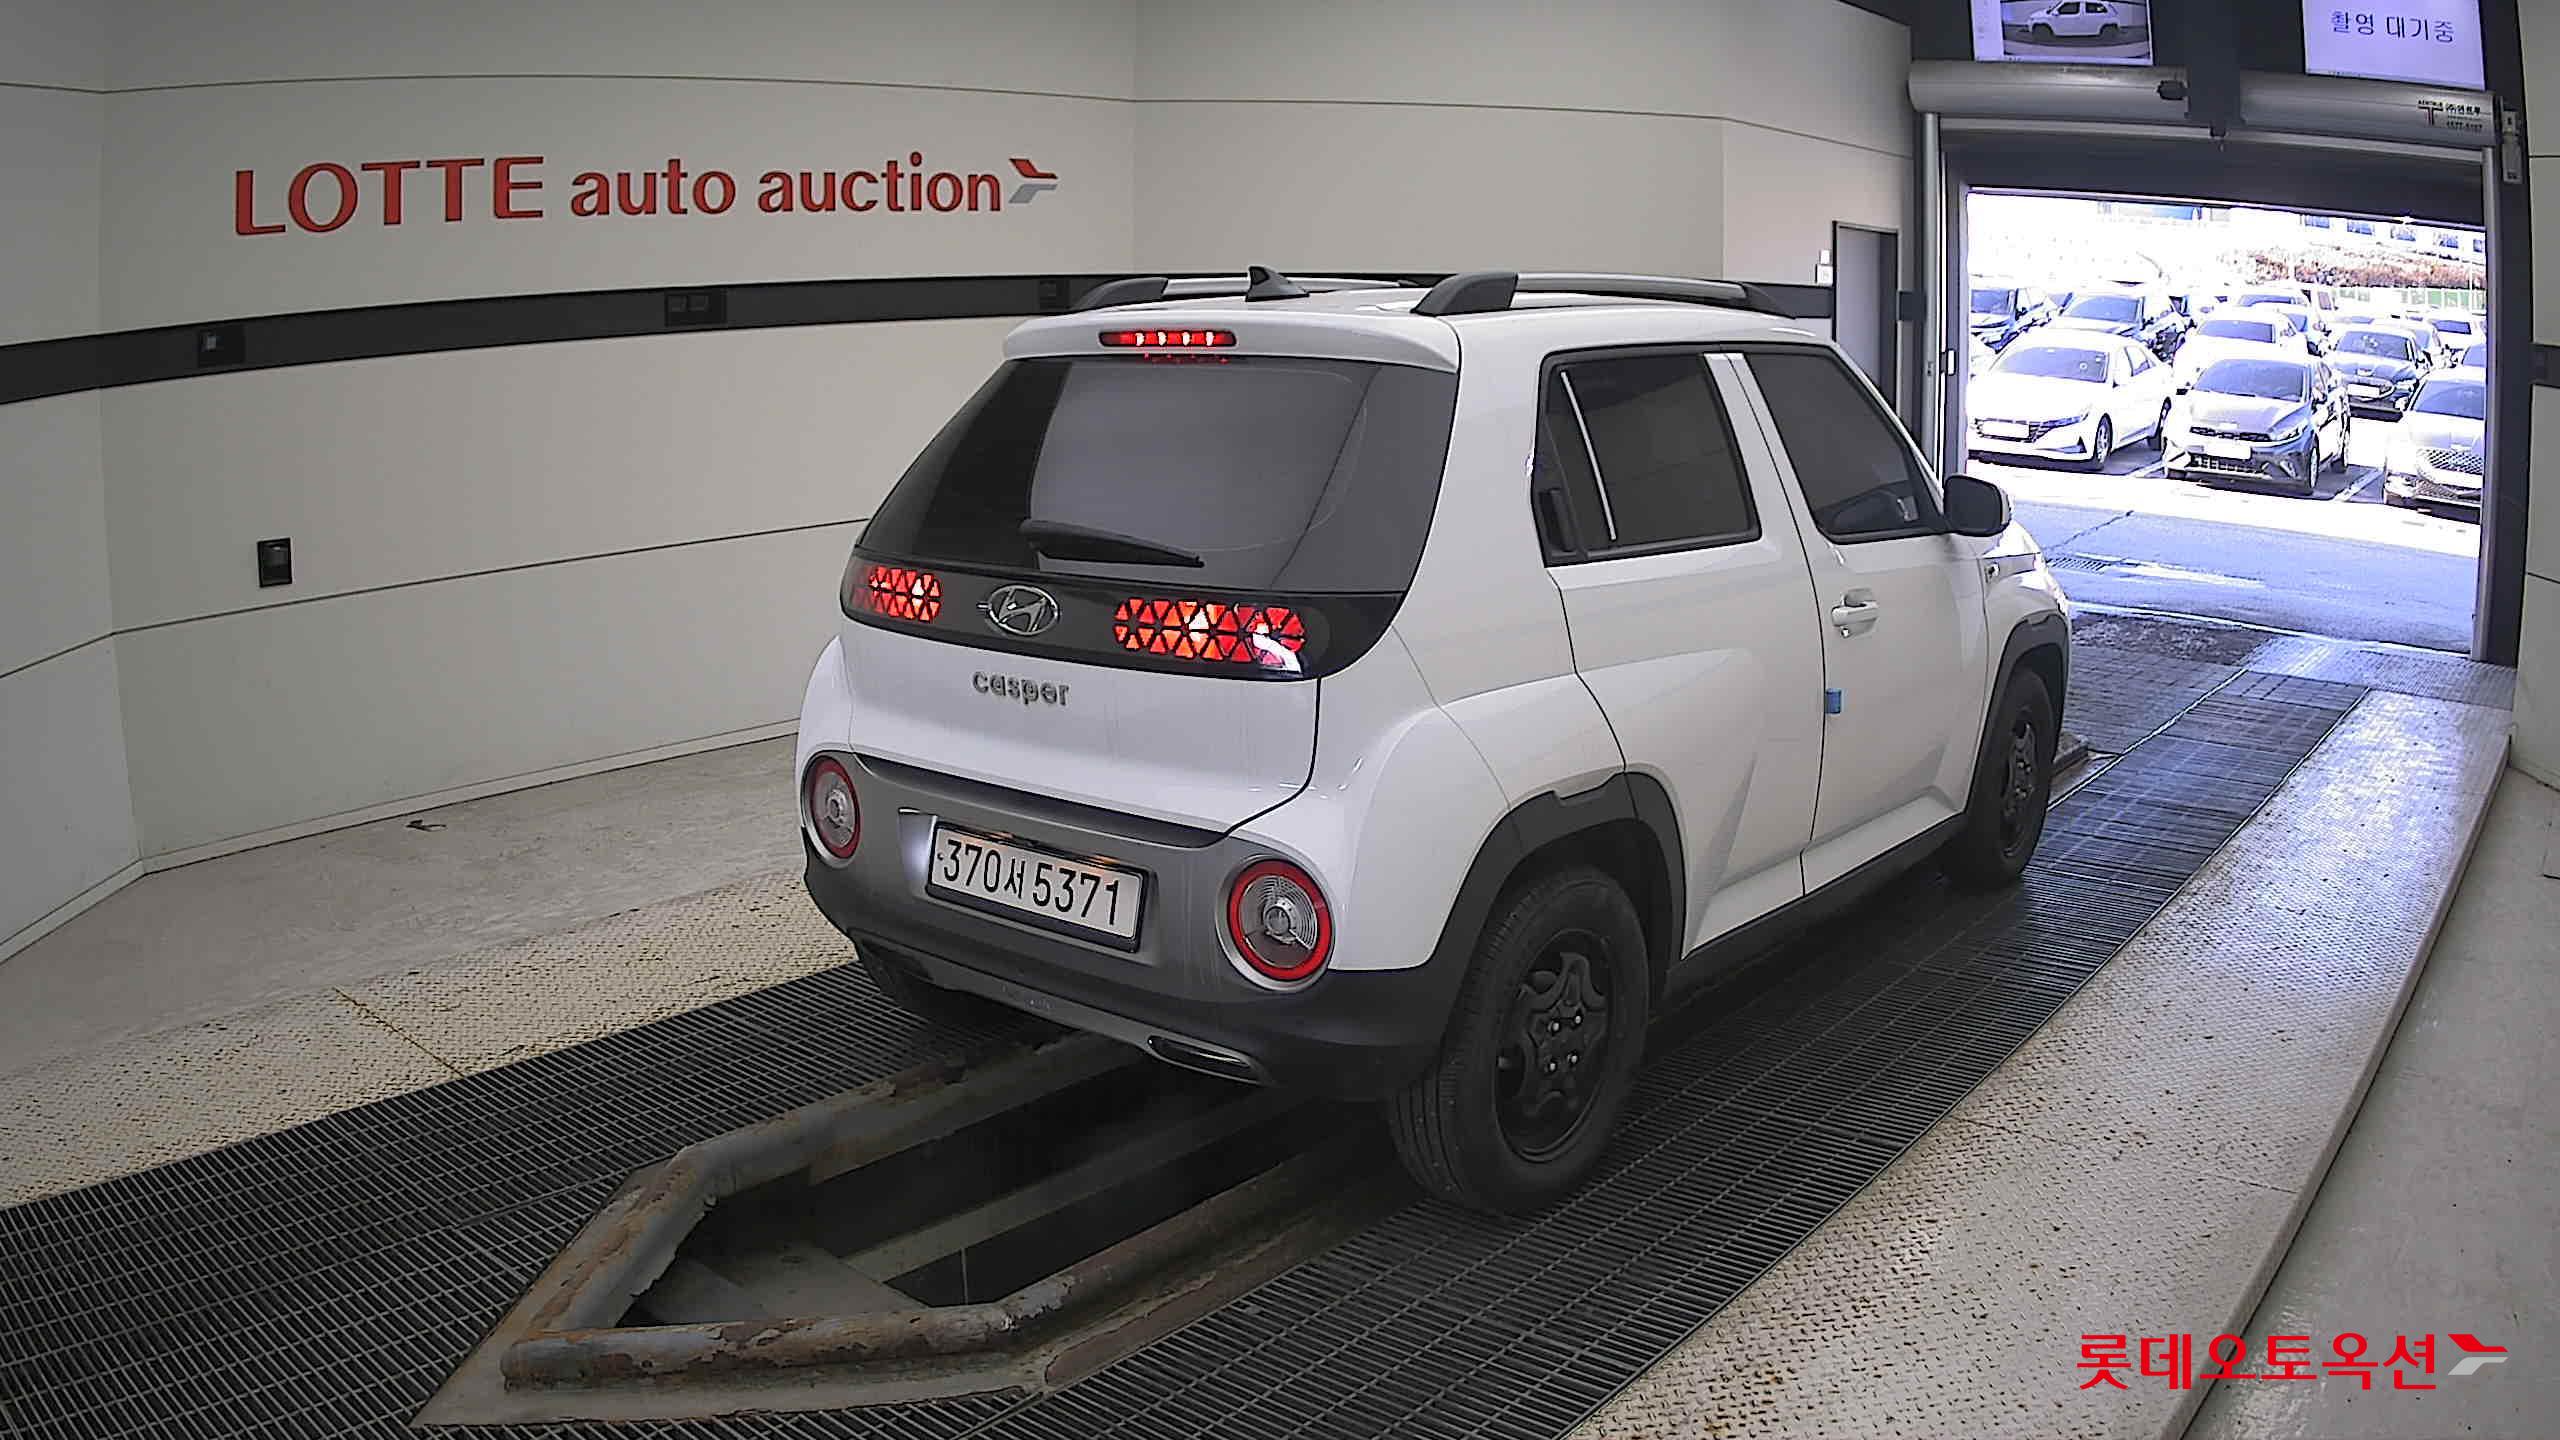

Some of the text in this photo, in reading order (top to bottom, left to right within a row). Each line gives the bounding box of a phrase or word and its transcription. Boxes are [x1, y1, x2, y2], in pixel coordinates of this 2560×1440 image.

[2331, 11, 2454, 43] 촬영 대기중
[235, 151, 1003, 236] LOTTE auto auction
[973, 671, 1070, 706] casper
[943, 839, 1120, 925] 370서 5371
